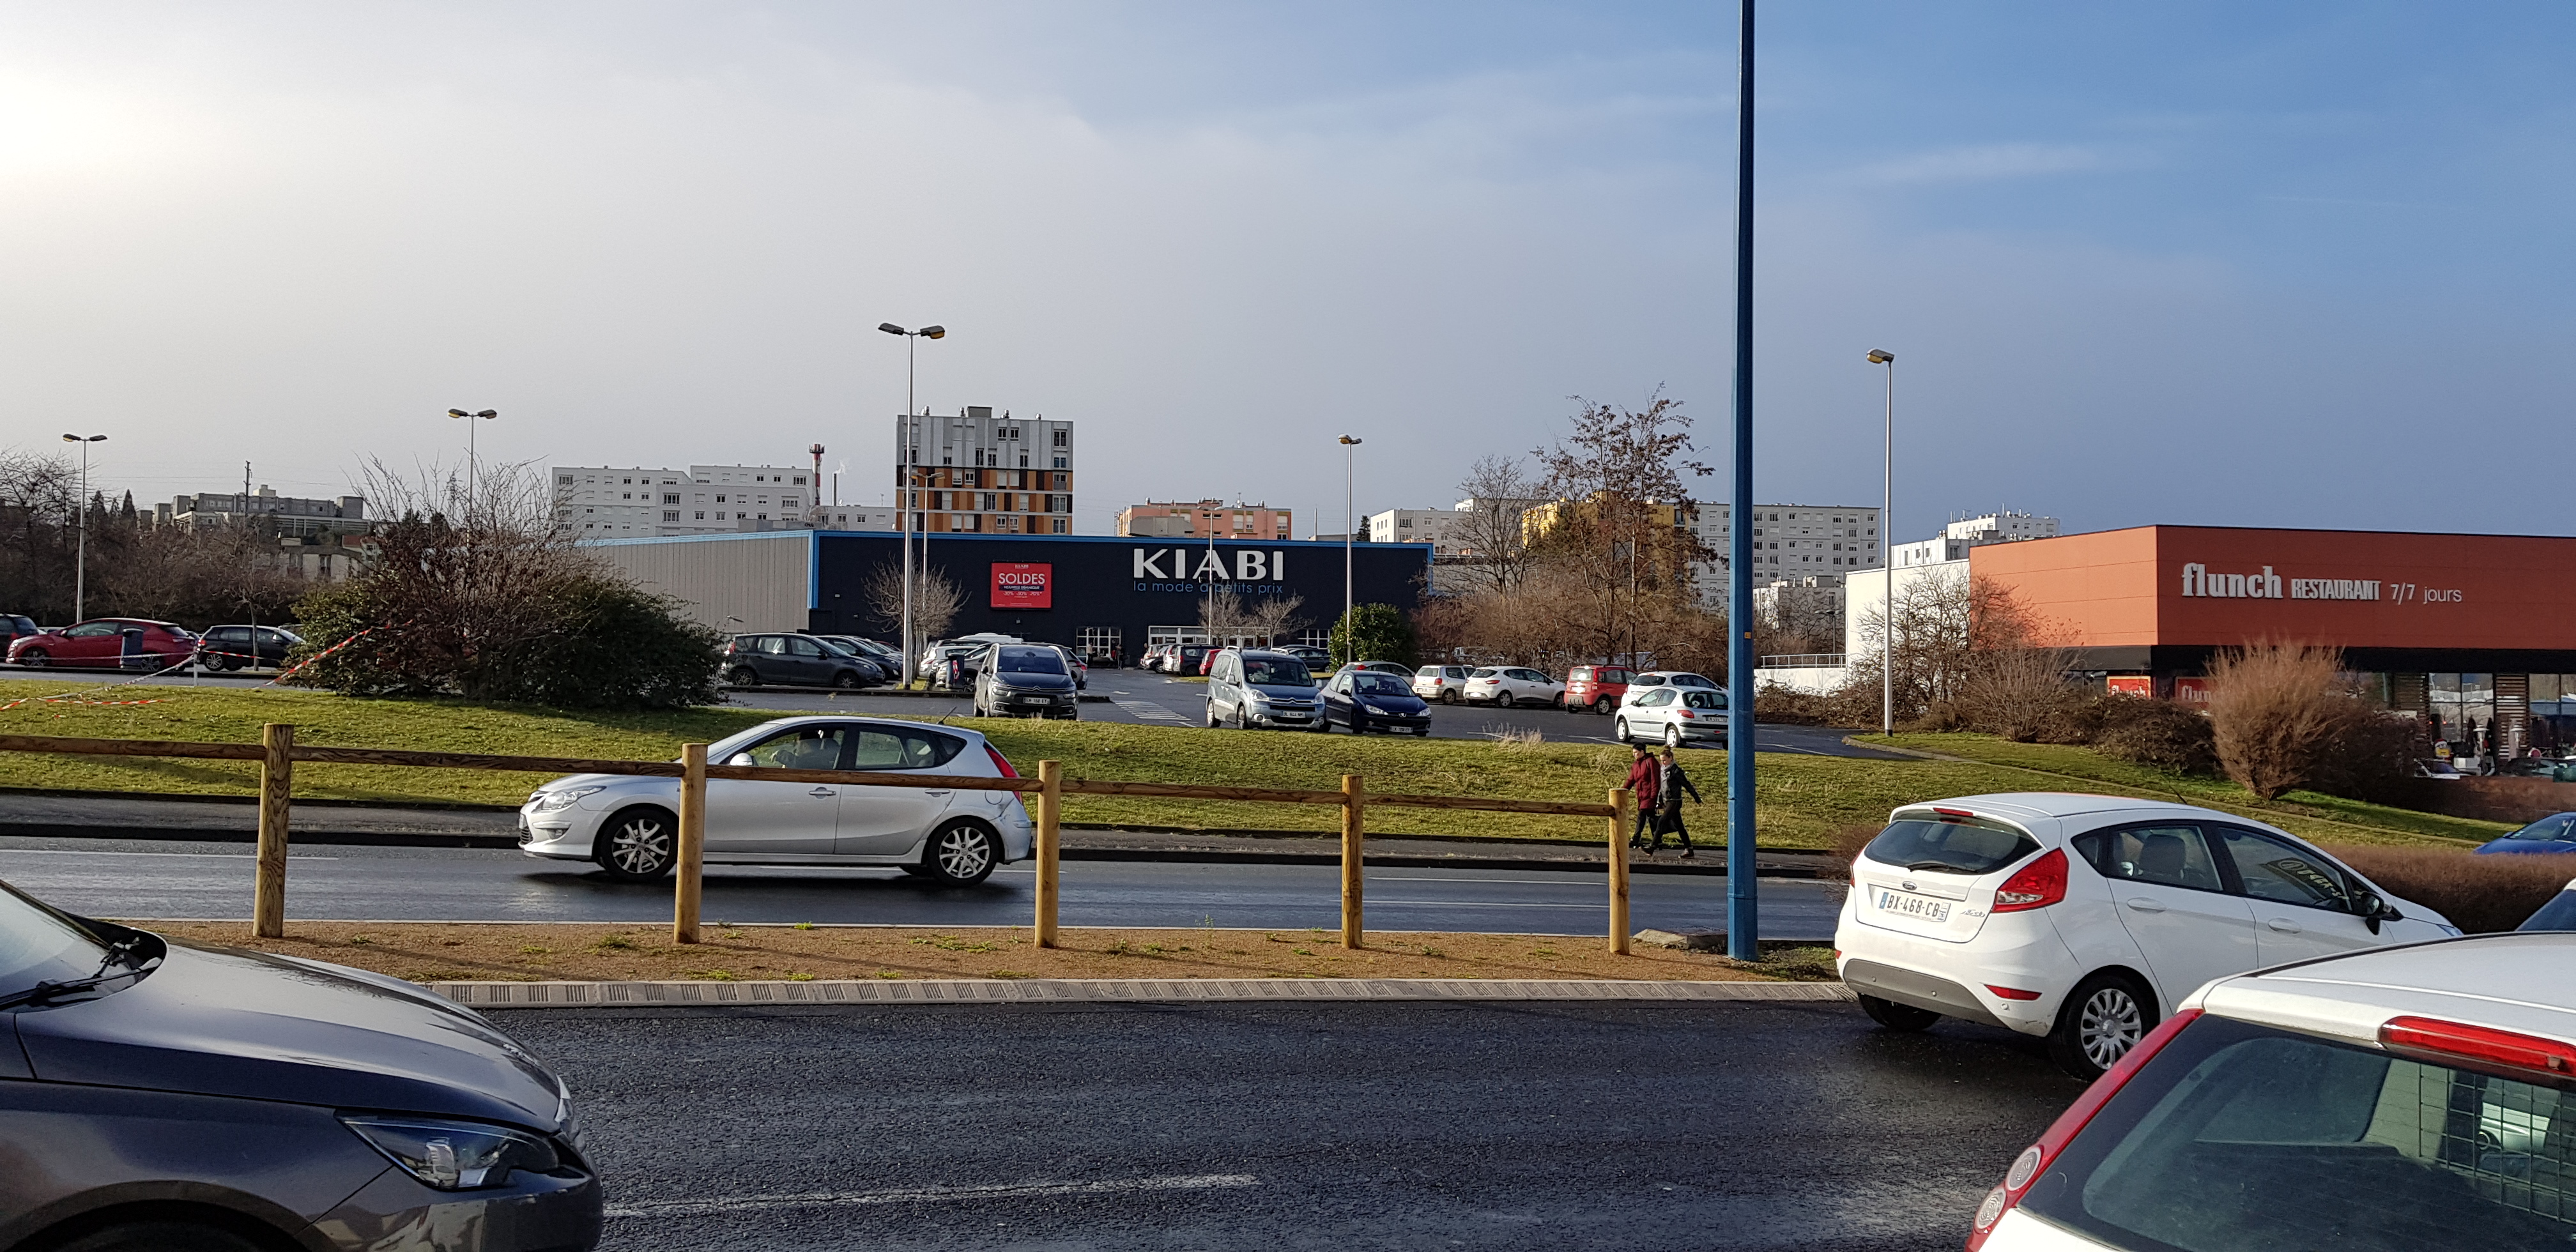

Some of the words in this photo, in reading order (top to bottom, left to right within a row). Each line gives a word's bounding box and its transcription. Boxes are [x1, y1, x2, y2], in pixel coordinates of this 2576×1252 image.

[1133, 548, 1284, 581] KIABI
[999, 573, 1045, 584] SOLDES
[1133, 580, 1146, 592] la
[1152, 581, 1193, 592] mode
[1215, 581, 1252, 595] petits
[1258, 582, 1283, 595] prix
[2182, 563, 2283, 599] flunch
[2292, 579, 2381, 600] RESTAURANT
[2391, 583, 2416, 605] 7/7
[2424, 586, 2462, 604] jours
[1887, 895, 1940, 917] BX-468-CB
